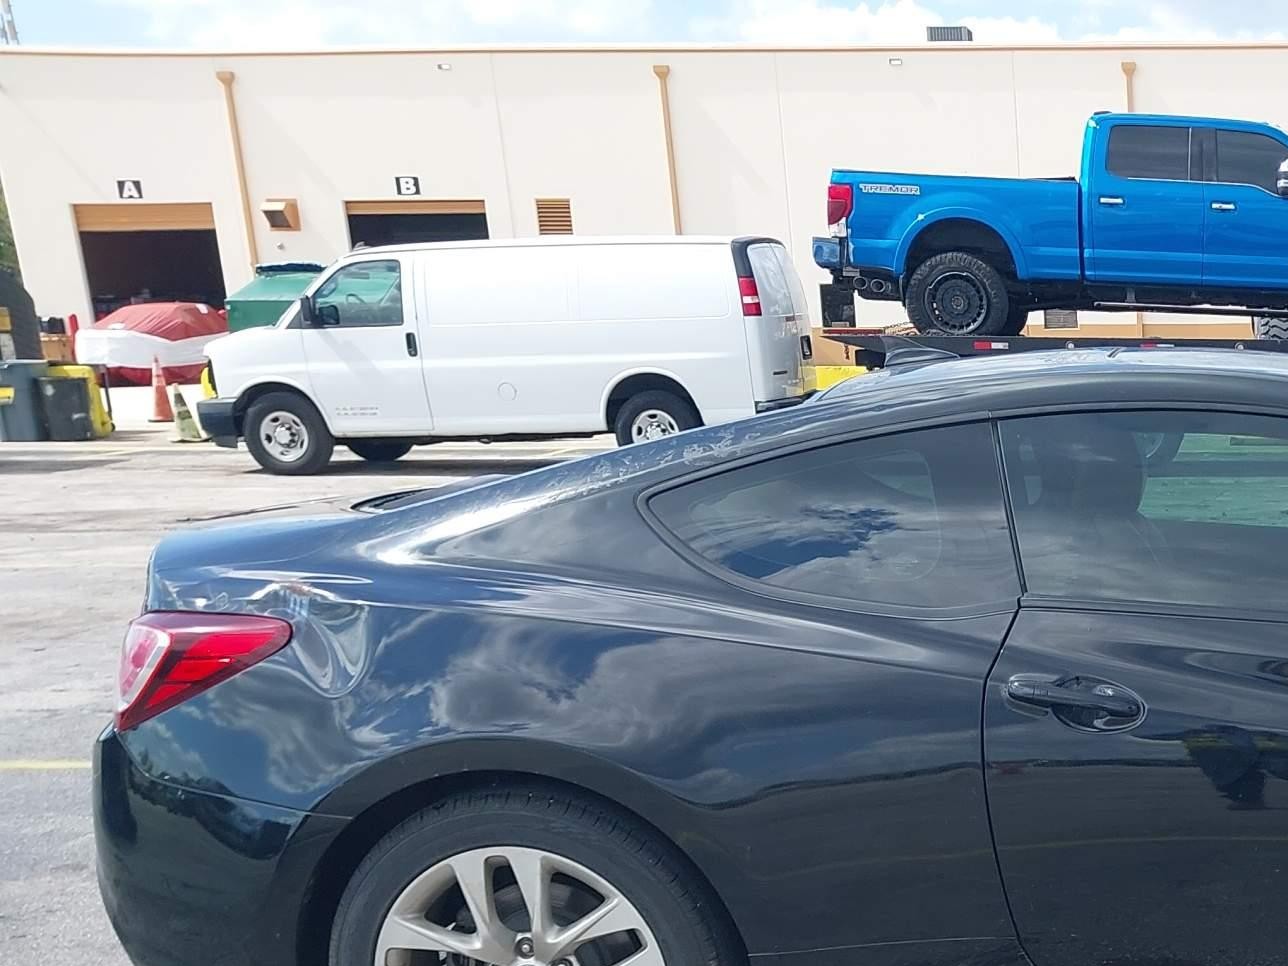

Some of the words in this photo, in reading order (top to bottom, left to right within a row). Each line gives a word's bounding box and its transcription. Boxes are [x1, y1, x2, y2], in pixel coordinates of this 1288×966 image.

[122, 180, 141, 198] A
[399, 177, 417, 195] B
[859, 183, 921, 196] TREMOR
